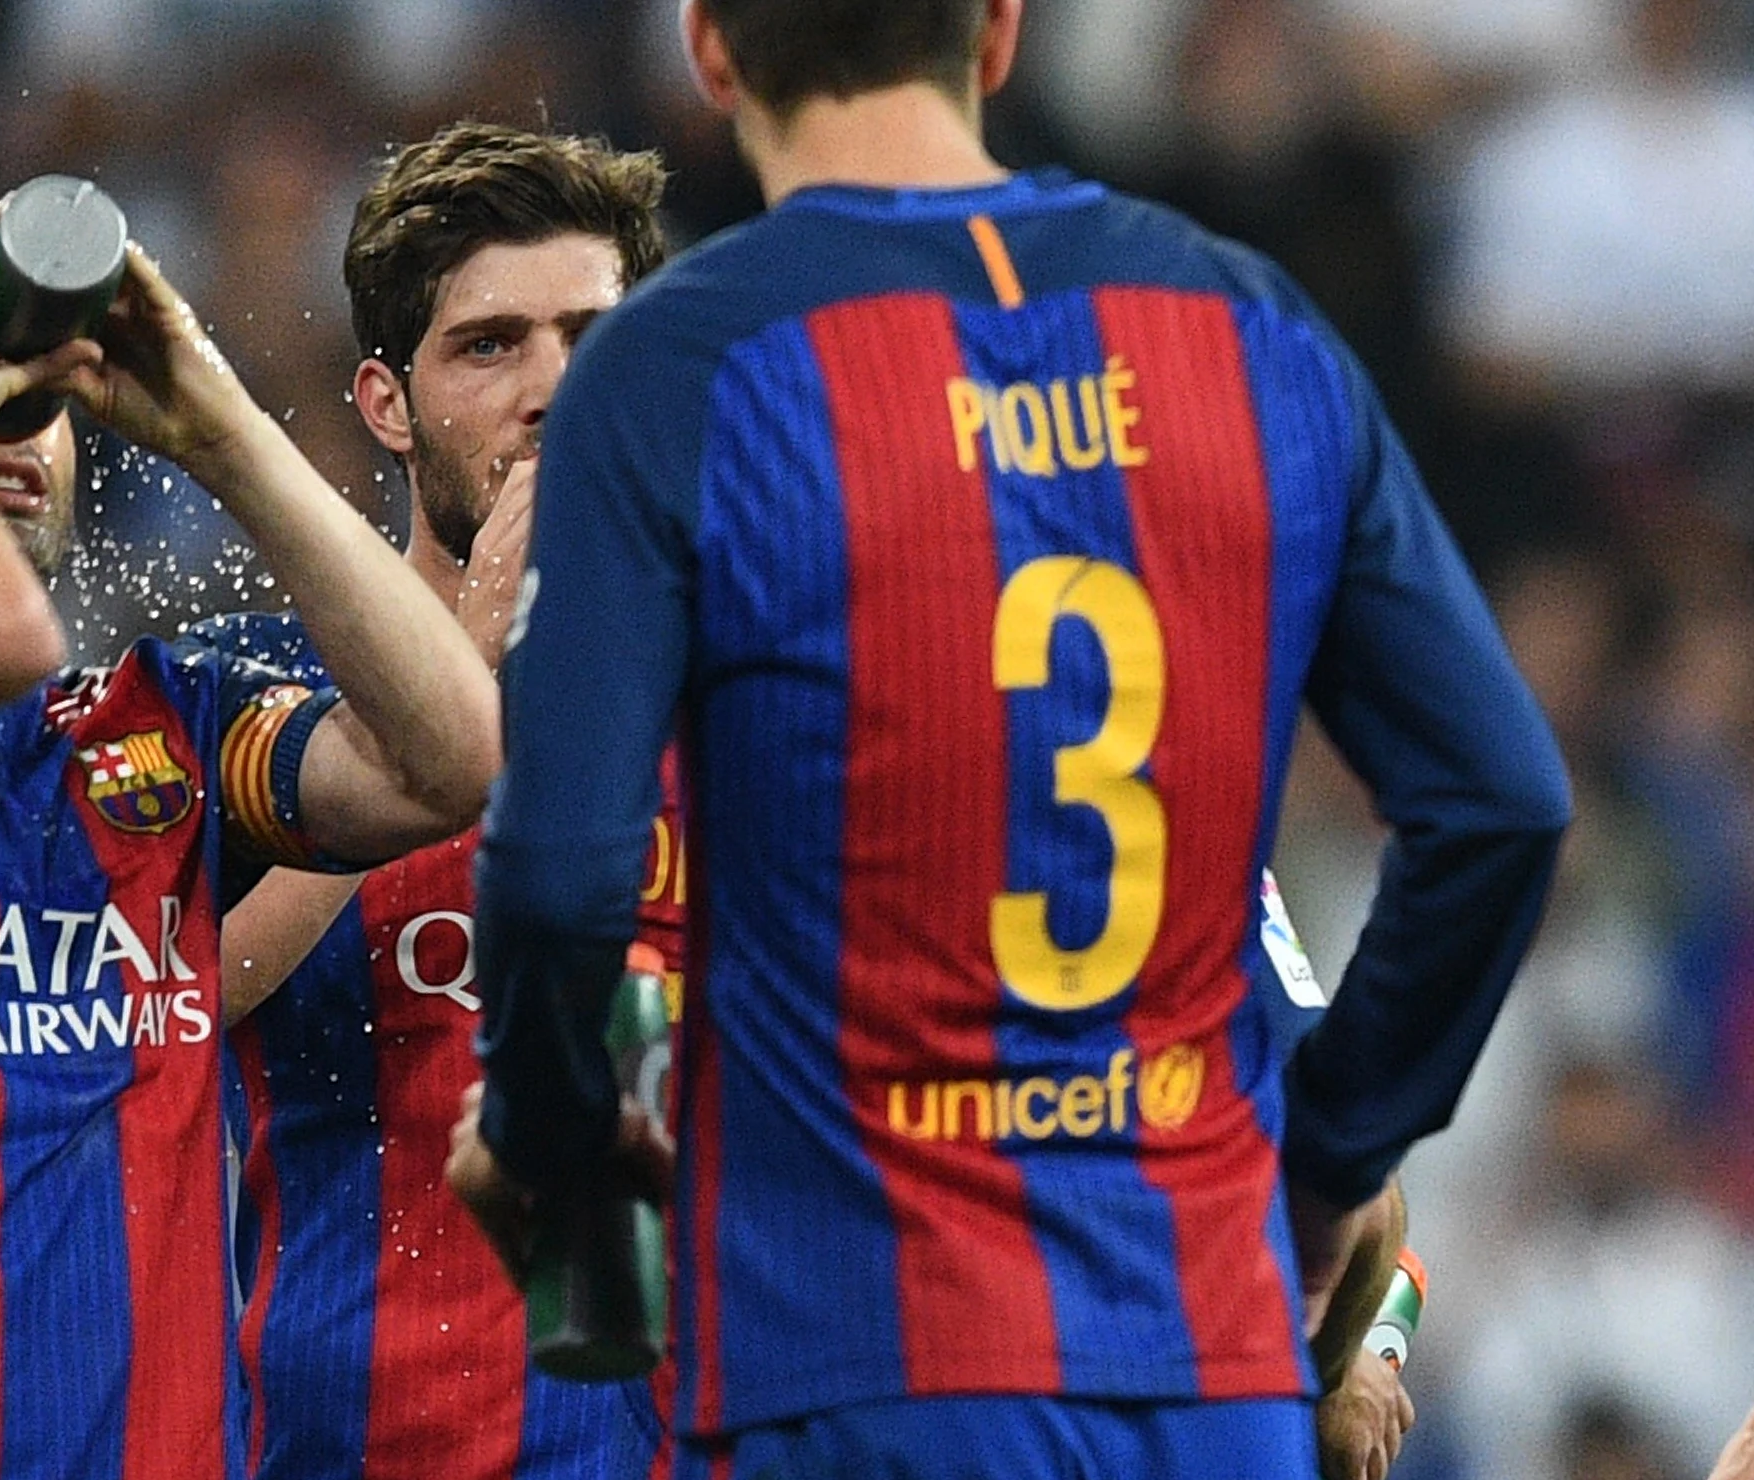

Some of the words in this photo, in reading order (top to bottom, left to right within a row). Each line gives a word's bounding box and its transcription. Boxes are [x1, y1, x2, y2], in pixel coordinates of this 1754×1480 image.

[947, 355, 1150, 477] PIQUÉ
[990, 555, 1168, 1012] 3
[887, 1046, 1135, 1141] unicef
